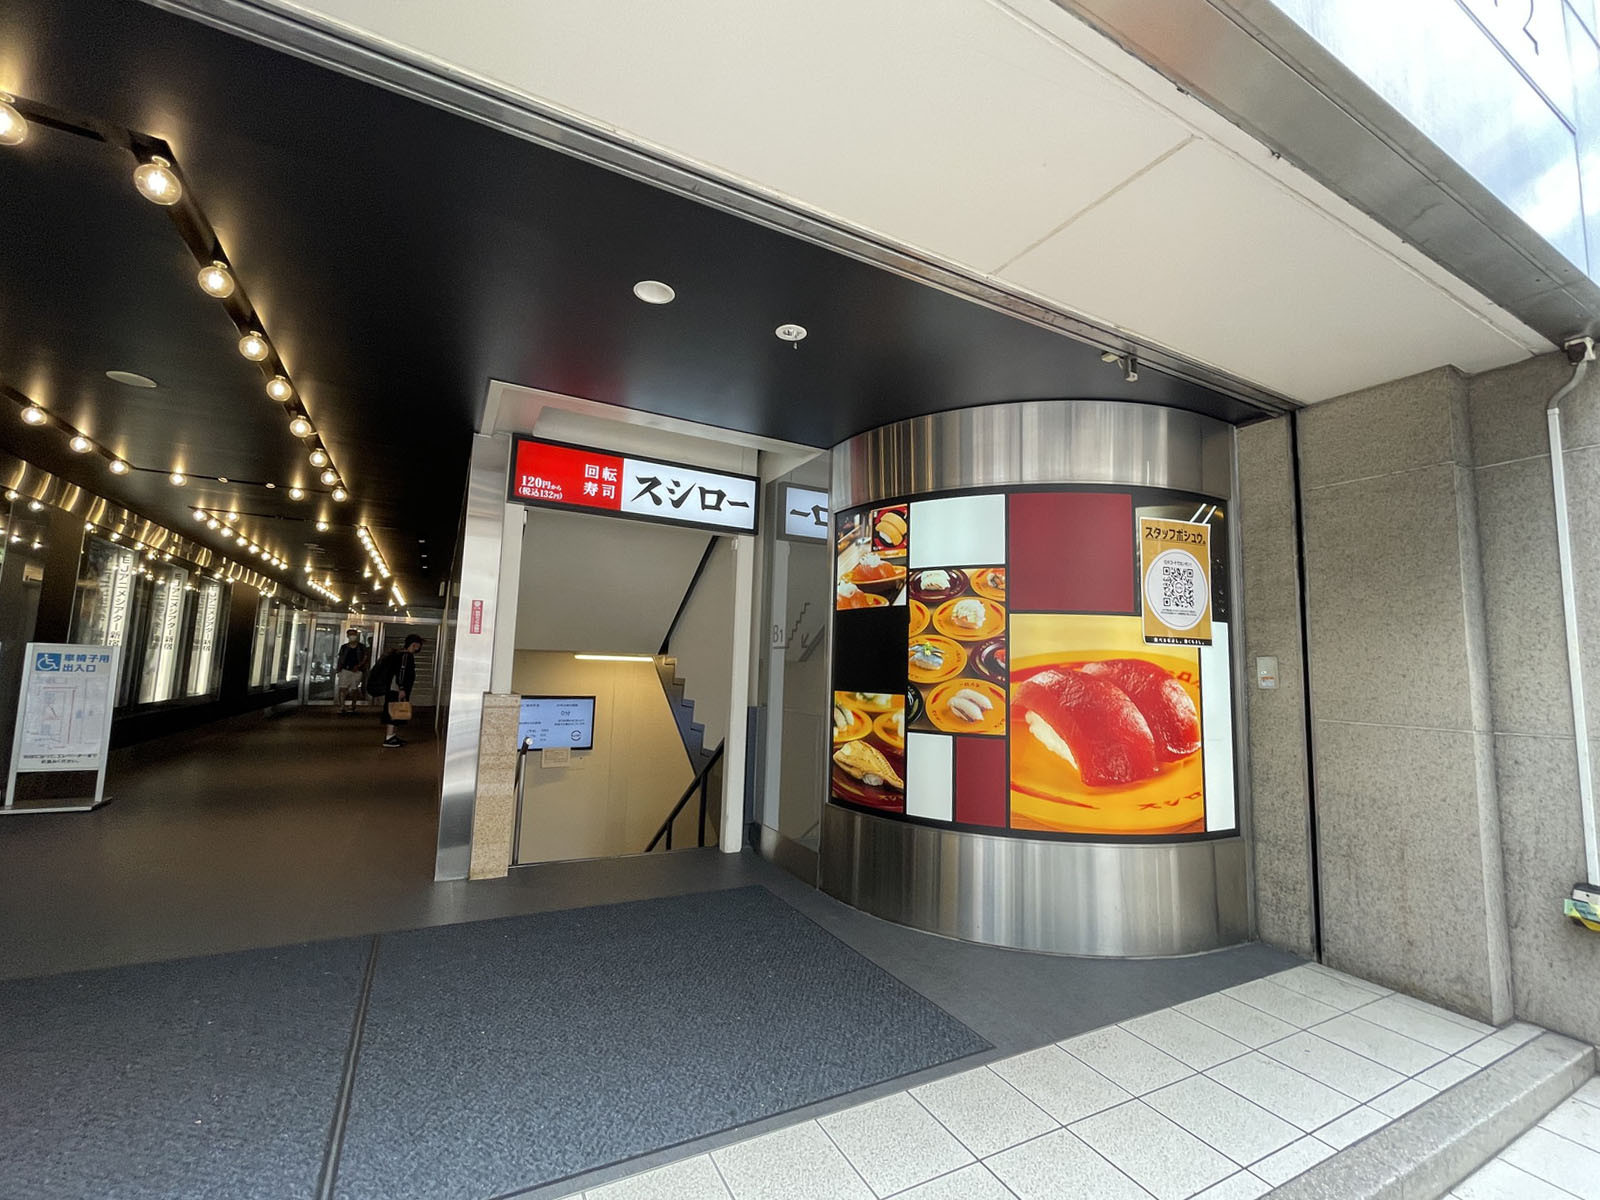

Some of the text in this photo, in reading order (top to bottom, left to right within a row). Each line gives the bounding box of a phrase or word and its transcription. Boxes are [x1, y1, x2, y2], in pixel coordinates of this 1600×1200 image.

[584, 462, 618, 483] 回転
[521, 475, 562, 492] 120円から
[583, 480, 616, 500] 寿司
[518, 486, 563, 500] (税込132円)
[631, 474, 750, 512] スシロー
[64, 653, 111, 663] 車椅子用
[62, 664, 97, 673] 出入口
